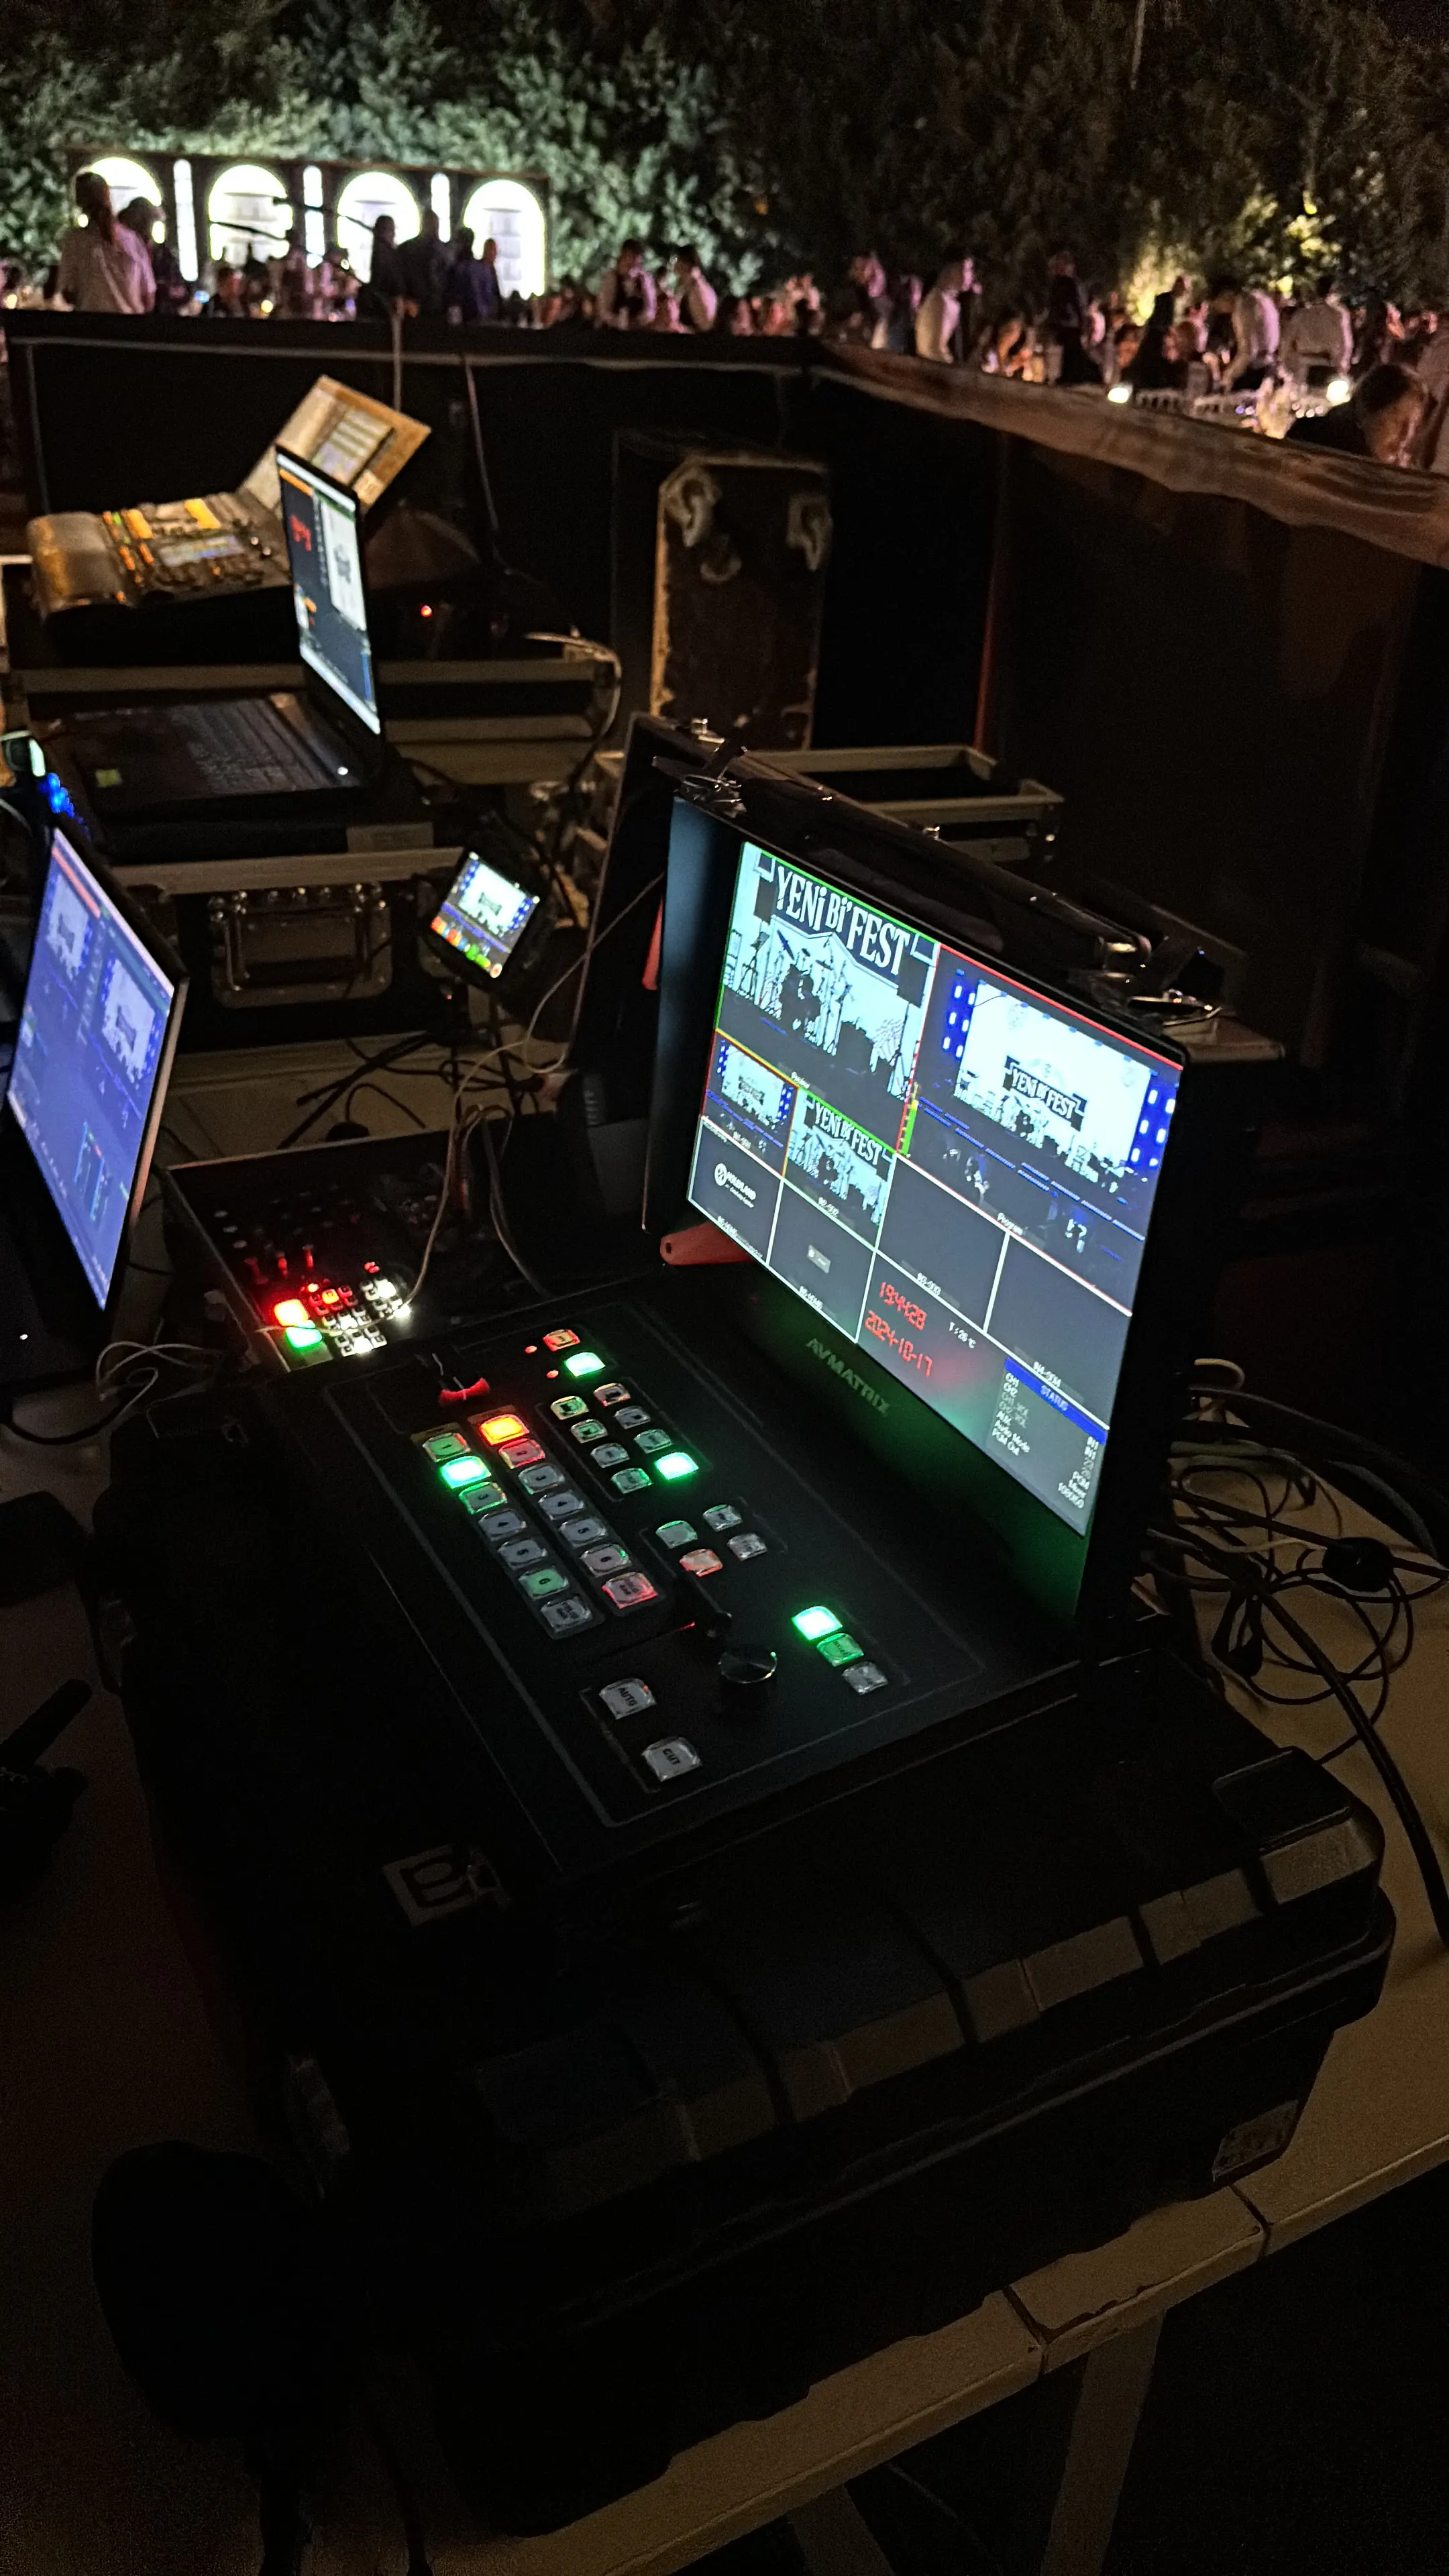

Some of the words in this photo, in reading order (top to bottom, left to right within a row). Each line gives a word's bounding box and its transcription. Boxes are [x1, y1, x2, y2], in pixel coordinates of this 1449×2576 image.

[847, 906, 910, 975] FEST
[1046, 1089, 1076, 1119] FEST
[851, 1132, 883, 1165] FEST
[865, 1309, 933, 1377] 2024-10-17
[806, 1338, 890, 1415] AVMATRIX
[619, 1687, 638, 1707] AUTO
[662, 1748, 680, 1765] CUT
